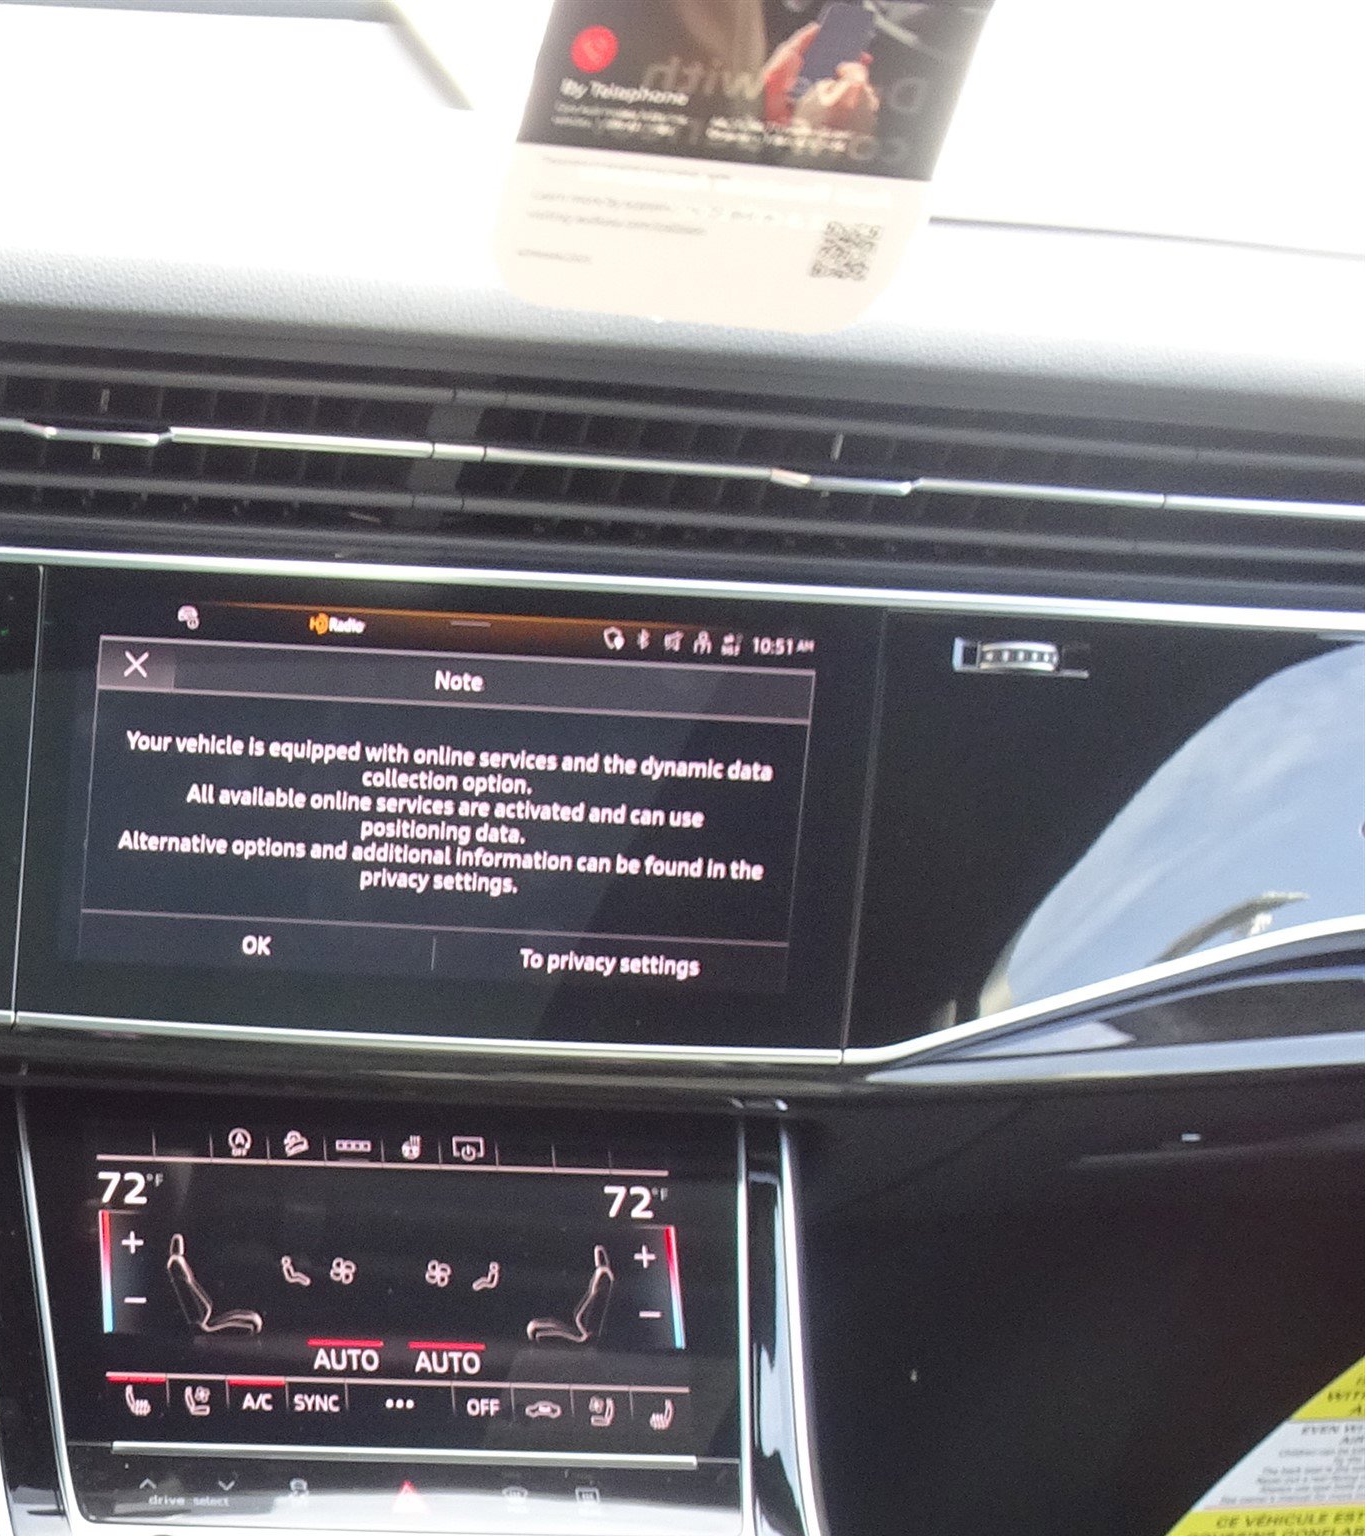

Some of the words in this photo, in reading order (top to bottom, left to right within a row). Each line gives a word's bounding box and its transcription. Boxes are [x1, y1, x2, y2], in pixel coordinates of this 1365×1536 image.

[560, 78, 588, 99] By
[590, 80, 689, 106] Telephone
[753, 636, 794, 655] 10:51
[434, 669, 485, 692] Note
[126, 730, 172, 752] Your
[175, 733, 244, 756] vehicle
[248, 736, 265, 757] is
[268, 739, 360, 764] equipped
[364, 742, 409, 764] with
[413, 745, 475, 768] online
[479, 750, 558, 771] services
[561, 752, 599, 773] and
[603, 754, 637, 775] the
[640, 755, 724, 781] dynamic
[727, 759, 774, 782] data
[362, 768, 457, 791] collection
[462, 773, 533, 797] option.
[186, 783, 216, 805] All
[219, 786, 306, 809] available
[310, 790, 372, 812] online
[376, 795, 455, 816] services
[458, 802, 490, 818] are
[493, 800, 585, 823] activated
[588, 804, 626, 825] and
[630, 809, 665, 827] can
[669, 810, 705, 829] use
[360, 819, 470, 846] positioning
[475, 822, 526, 845] data.
[118, 829, 228, 854] Alternative
[232, 836, 306, 860] options
[310, 839, 347, 861] and
[352, 842, 452, 866] additional
[456, 847, 573, 872] information
[576, 855, 611, 873] can
[616, 852, 641, 875] be
[644, 854, 703, 878] found
[707, 858, 726, 879] in
[730, 859, 765, 881] the
[359, 868, 429, 893] privacy
[432, 871, 519, 898] settings.
[241, 935, 272, 957] OK
[519, 947, 544, 970] To
[547, 950, 617, 977] privacy
[619, 954, 702, 981] settings
[313, 1348, 380, 1372] AUTO
[414, 1351, 481, 1375] AUTO
[242, 1392, 273, 1412] A/C
[294, 1393, 340, 1413] SYNC
[466, 1398, 501, 1417] OFF
[148, 1494, 186, 1506] drive
